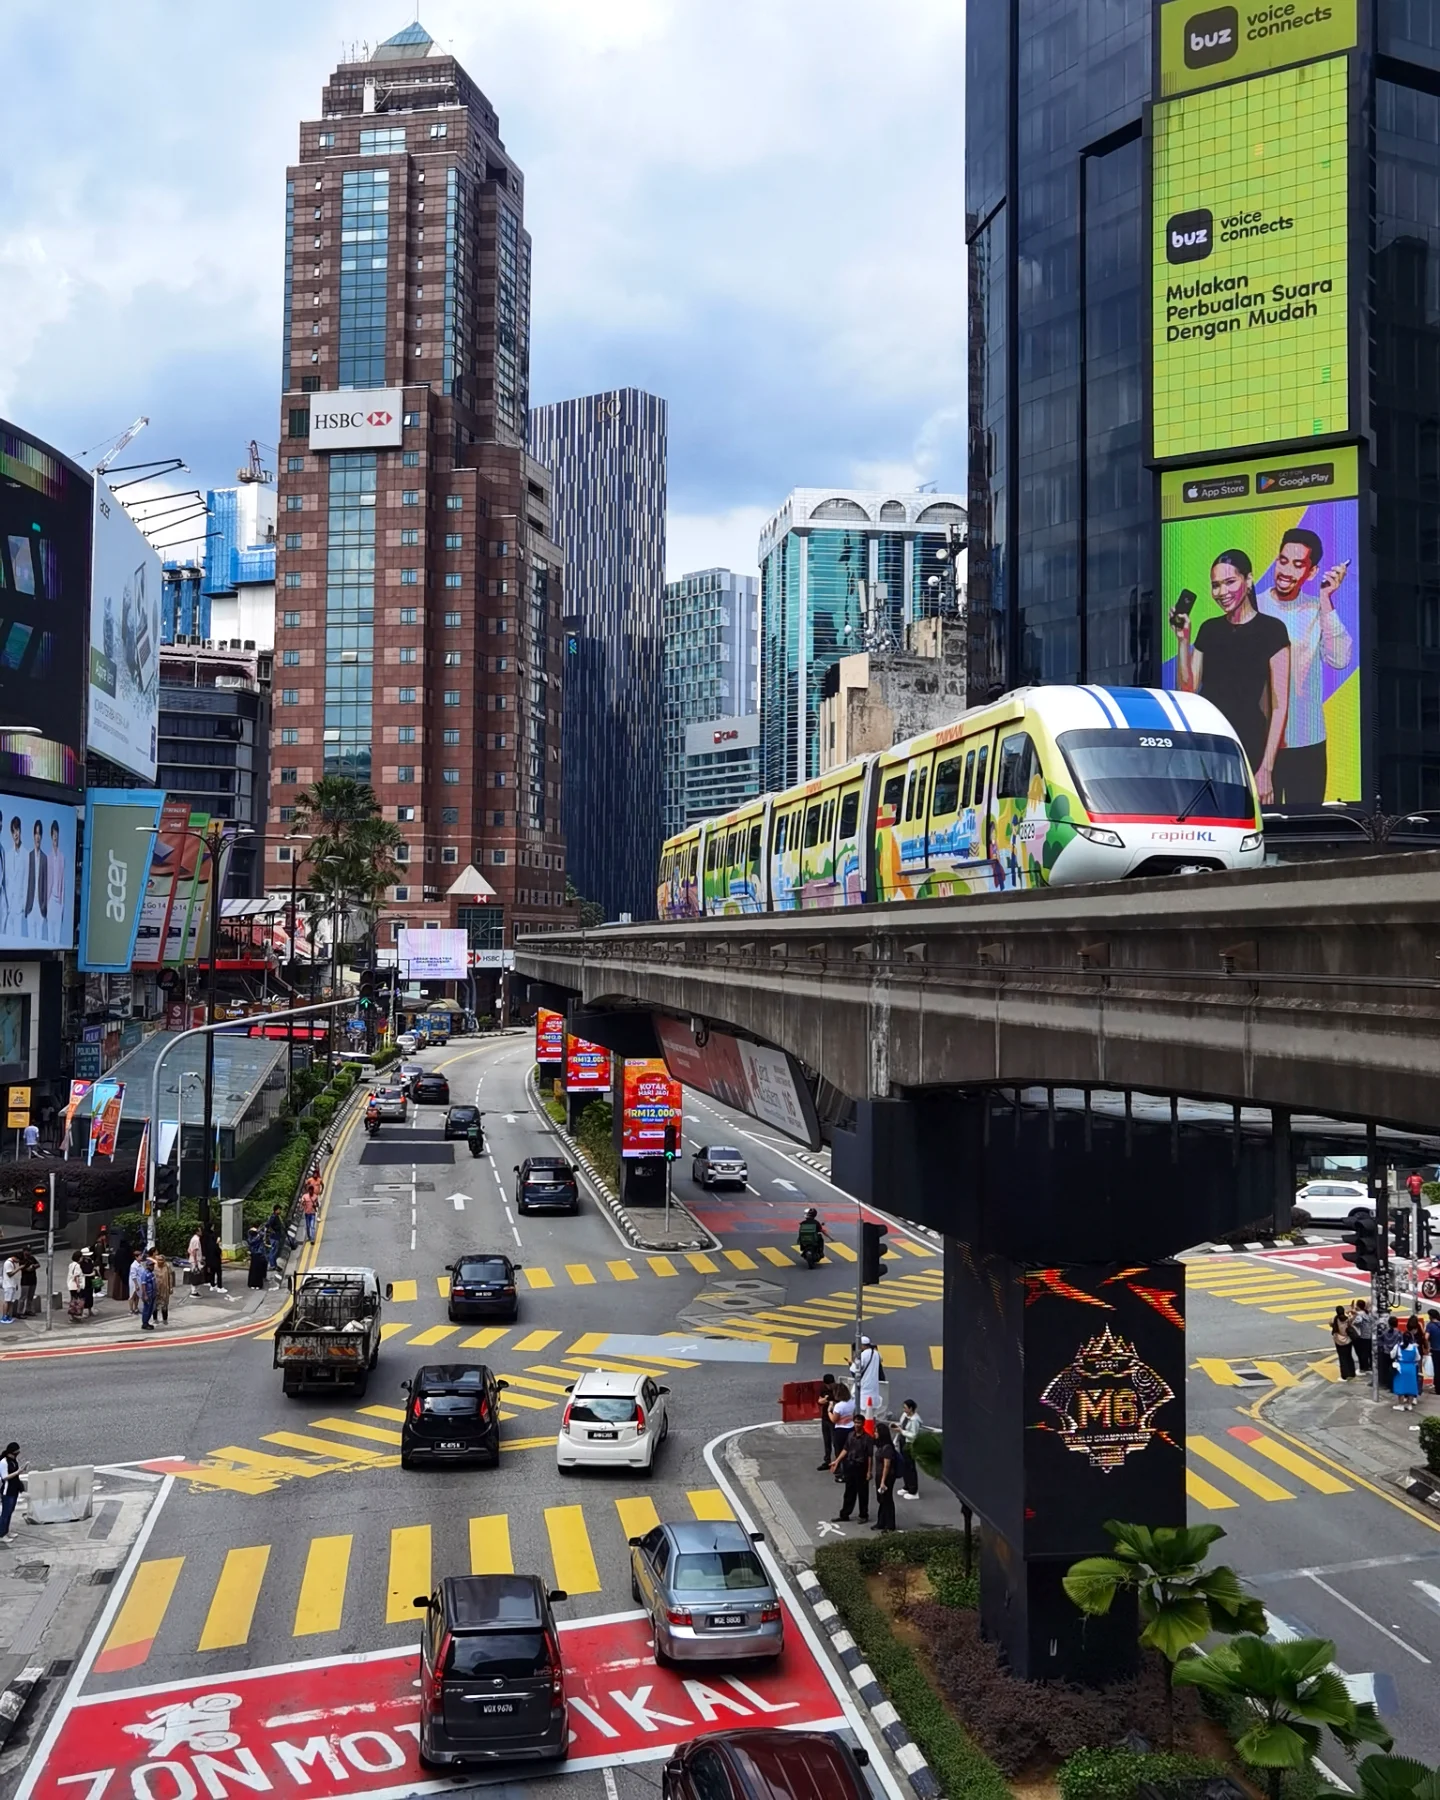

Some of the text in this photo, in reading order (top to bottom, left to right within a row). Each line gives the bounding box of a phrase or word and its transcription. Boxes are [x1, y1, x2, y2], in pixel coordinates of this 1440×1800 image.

[1247, 4, 1295, 26] voice
[1247, 7, 1332, 41] connects
[1190, 28, 1232, 51] buz
[1220, 211, 1262, 229] voice
[1220, 216, 1294, 242] connects
[1171, 229, 1208, 248] buz
[1166, 275, 1249, 303] Mulakan
[1166, 279, 1333, 322] Perbualan Suara
[1166, 299, 1318, 342] Dengan Mudah
[314, 412, 364, 430] HSBC
[1278, 473, 1330, 487] Google Play
[1201, 485, 1245, 498] App Store
[1139, 737, 1173, 748] 2829
[1020, 822, 1035, 840] 2829
[106, 849, 127, 922] acer
